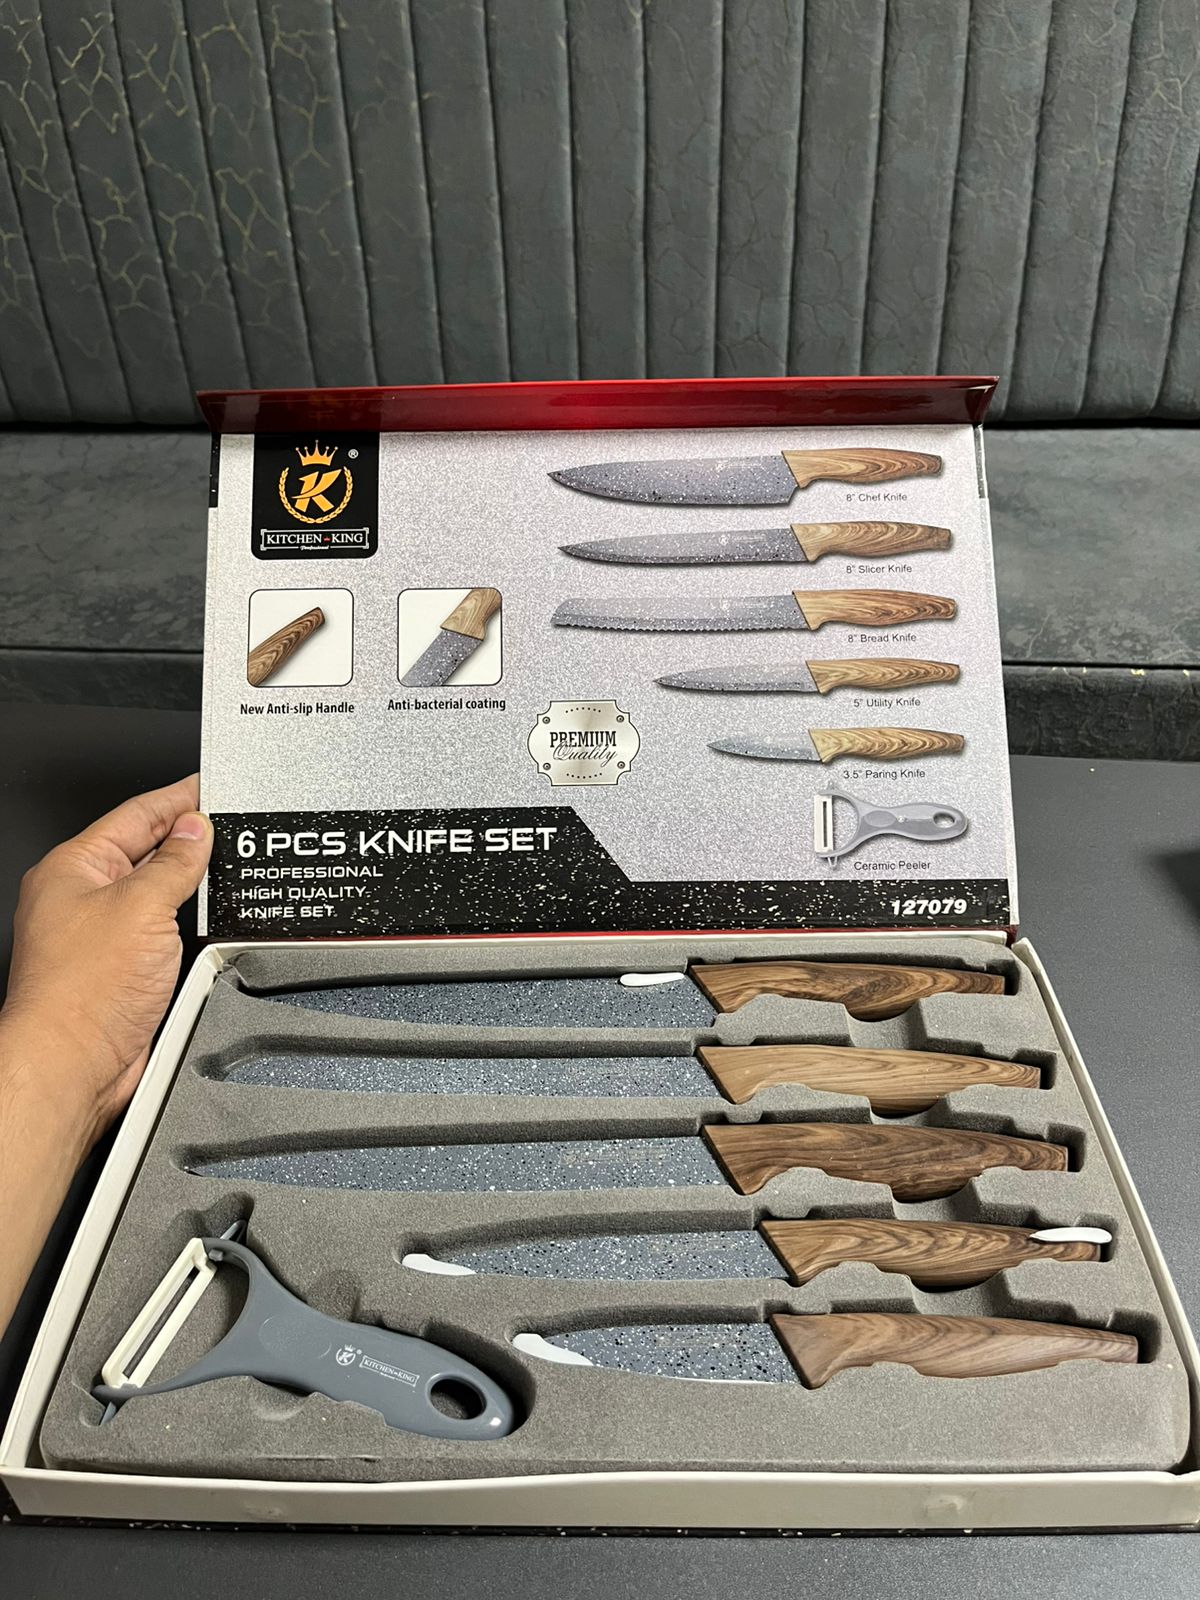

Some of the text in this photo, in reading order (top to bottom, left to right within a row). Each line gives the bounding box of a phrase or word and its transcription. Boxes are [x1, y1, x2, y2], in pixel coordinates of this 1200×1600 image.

[858, 493, 880, 502] Chef
[883, 493, 908, 502] Knife
[266, 533, 363, 544] KITCHEN KING
[858, 564, 885, 574] Slicer
[888, 564, 913, 573] Knife
[860, 633, 889, 643] Bread
[892, 632, 917, 642] Knife
[240, 702, 355, 716] New Anti-slip Handle
[387, 698, 506, 712] Anti-bacterial coating
[866, 697, 893, 709] Utility
[896, 697, 921, 707] Knife
[549, 731, 617, 748] PREMIUM
[553, 740, 618, 768] Quality
[865, 770, 897, 780] Paring
[900, 769, 926, 778] Knife
[237, 826, 558, 858] 6 PCS KNIFE SET
[241, 866, 384, 879] PROFESSIONAL
[853, 860, 931, 871] Ceramic Peeler
[241, 886, 367, 900] HIGH QUALITY
[241, 905, 335, 919] KNIFE SET
[892, 899, 967, 915] 127079
[364, 1359, 395, 1374] KITCHEN
[397, 1371, 416, 1382] KING
